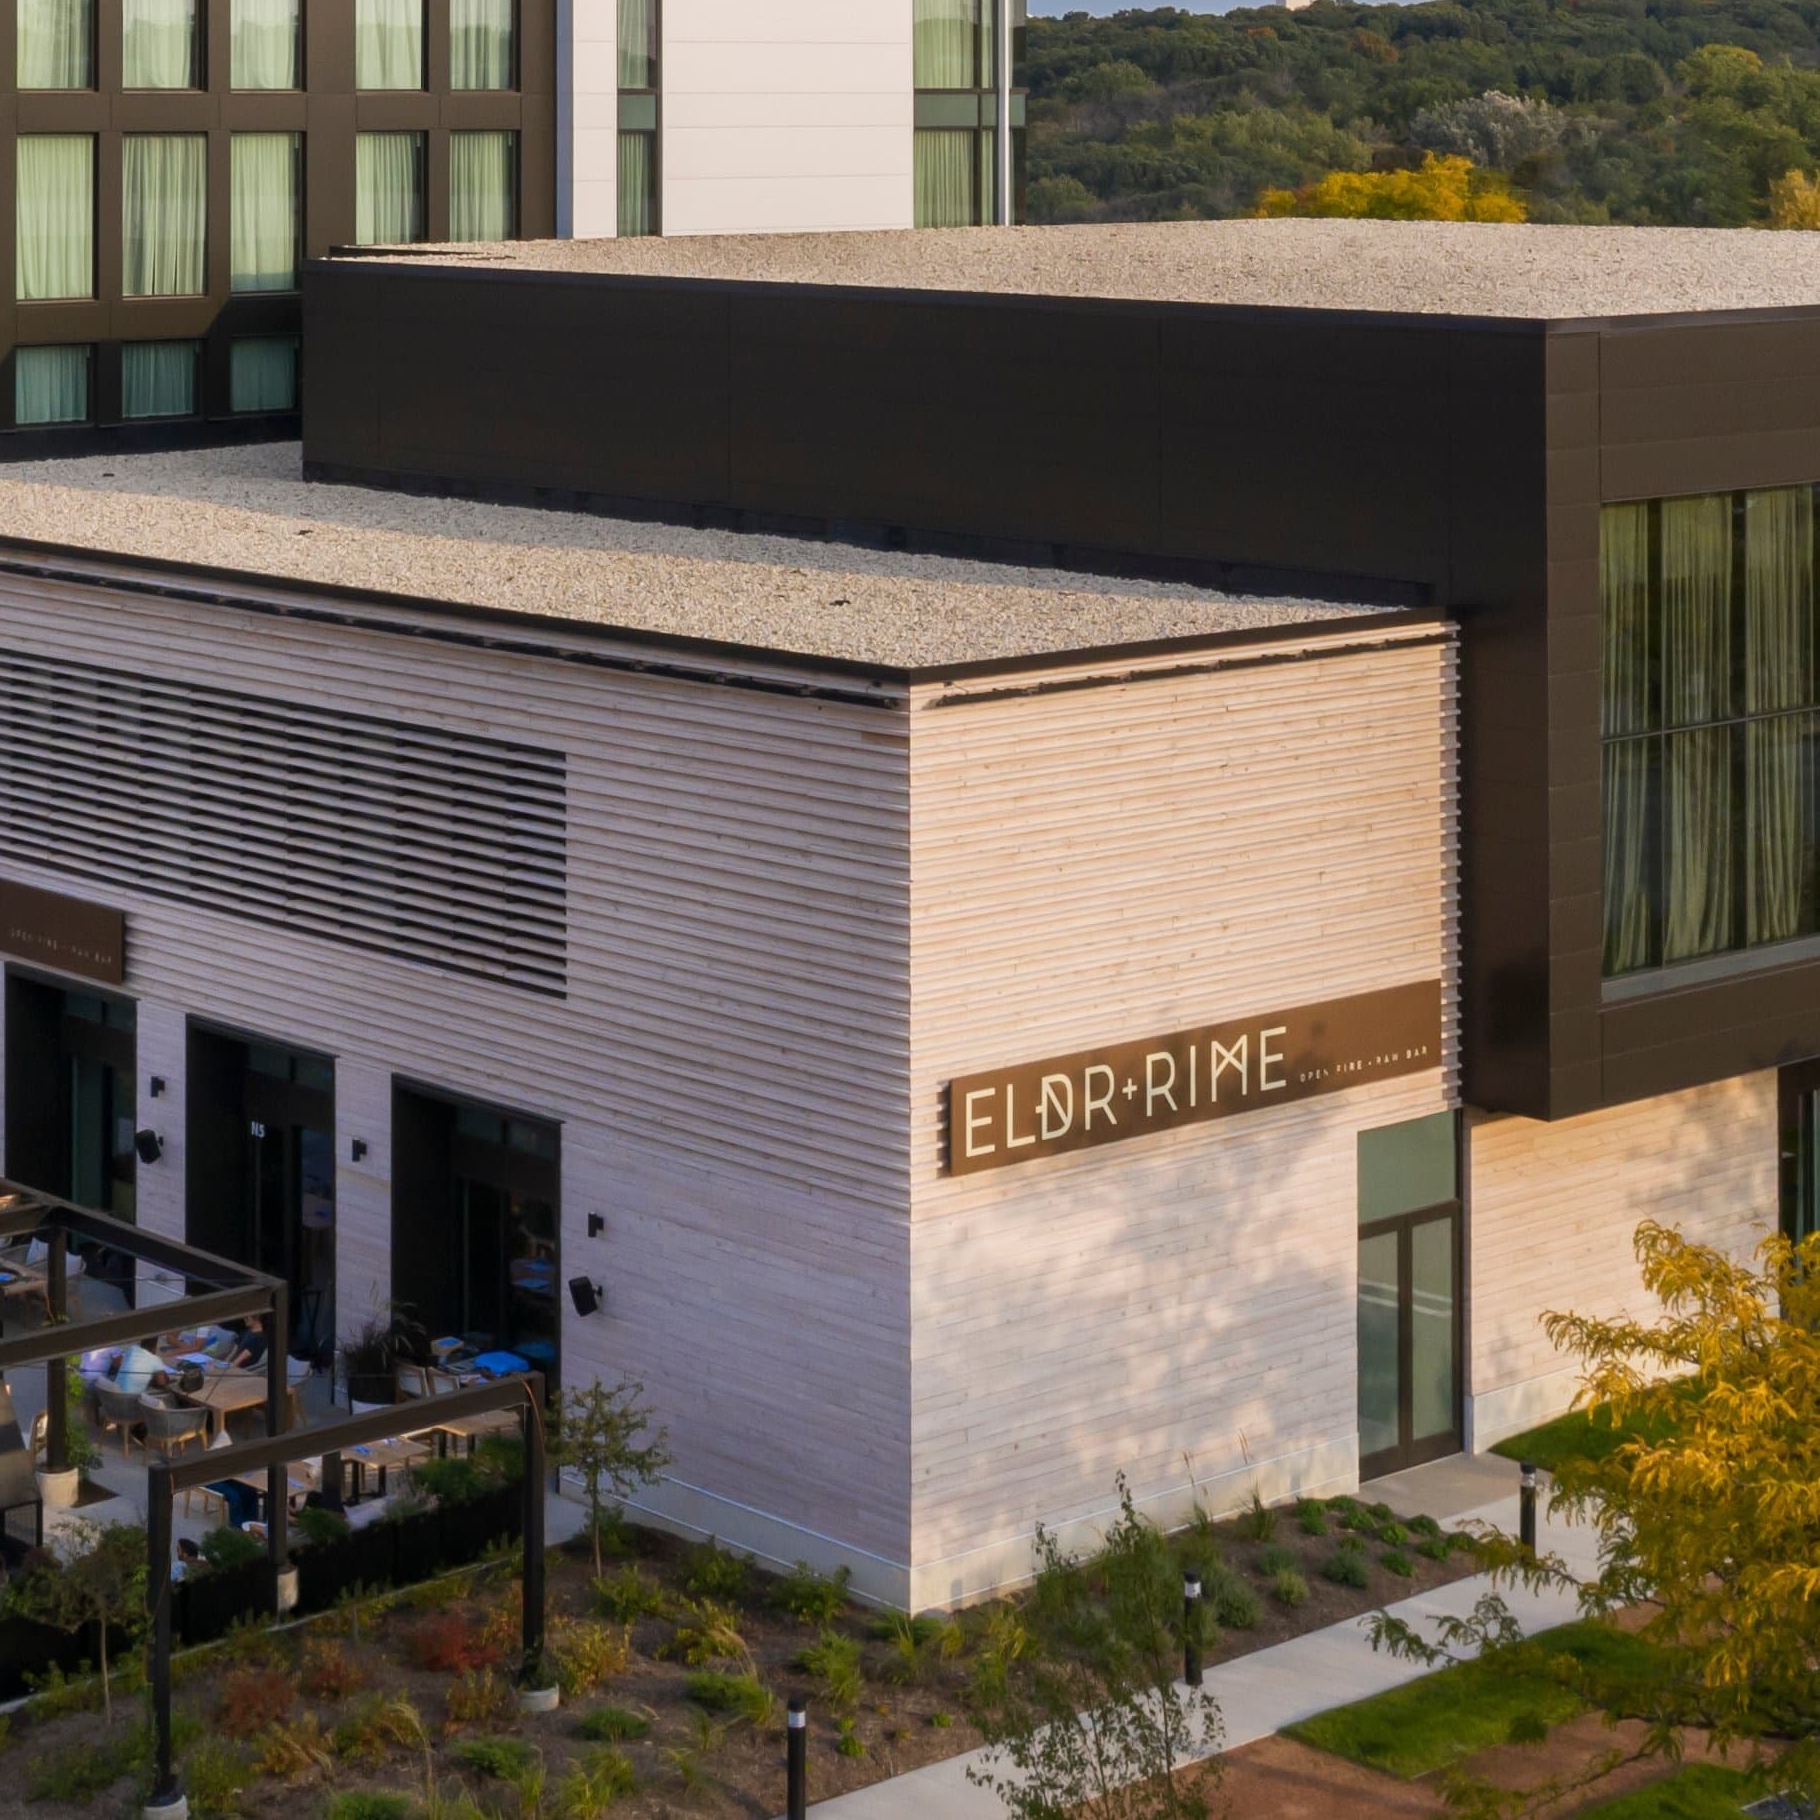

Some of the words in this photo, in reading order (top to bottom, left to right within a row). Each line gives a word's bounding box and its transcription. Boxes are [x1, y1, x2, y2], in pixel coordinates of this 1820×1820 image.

[1299, 1069, 1329, 1083] OPEN
[1336, 1060, 1363, 1072] FIRE
[1376, 1052, 1399, 1065] RAW
[1406, 1045, 1428, 1060] BAR
